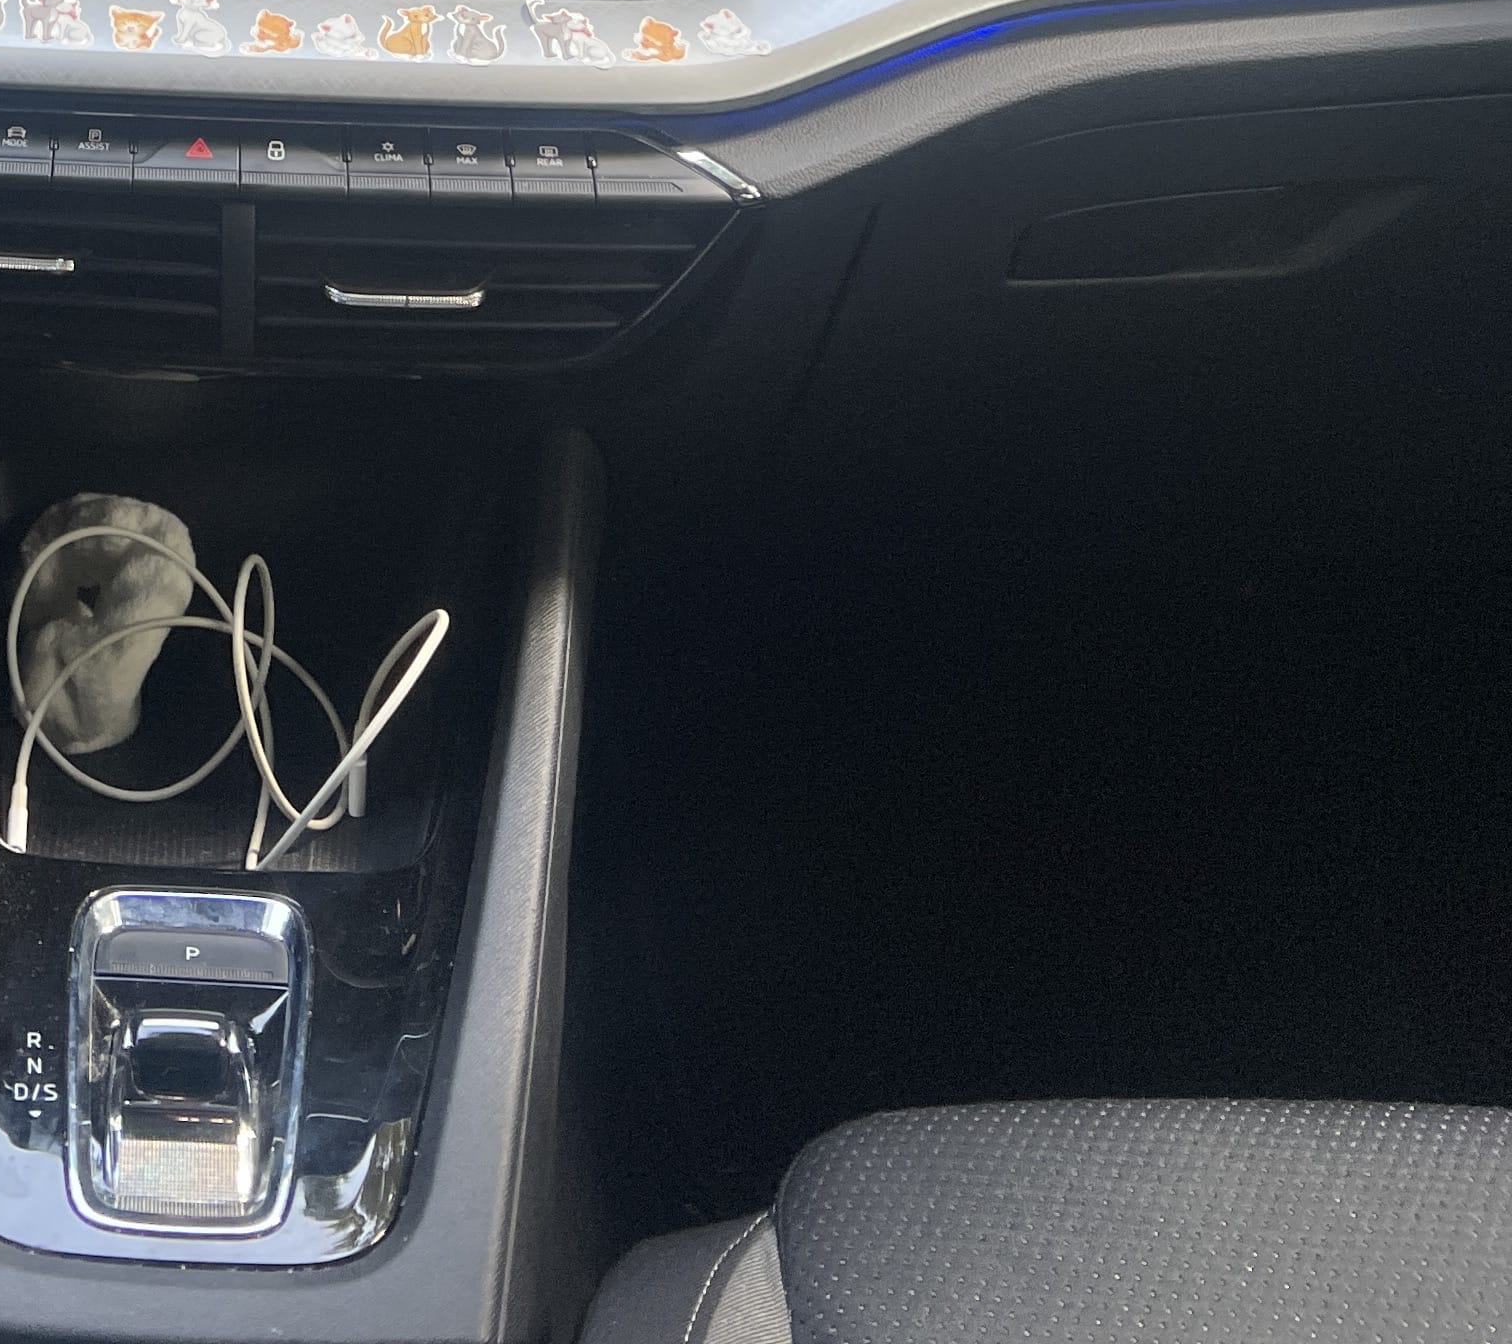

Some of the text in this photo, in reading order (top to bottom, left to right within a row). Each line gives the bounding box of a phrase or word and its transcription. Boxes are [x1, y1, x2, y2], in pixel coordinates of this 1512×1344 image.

[1, 139, 28, 148] MODE
[78, 142, 110, 151] ASSIST
[374, 153, 404, 162] CLIMA
[456, 156, 478, 165] MAX
[536, 157, 564, 167] REAR
[186, 946, 200, 961] P
[27, 1031, 42, 1048] R
[27, 1057, 43, 1074] N
[14, 1083, 58, 1101] D/S
